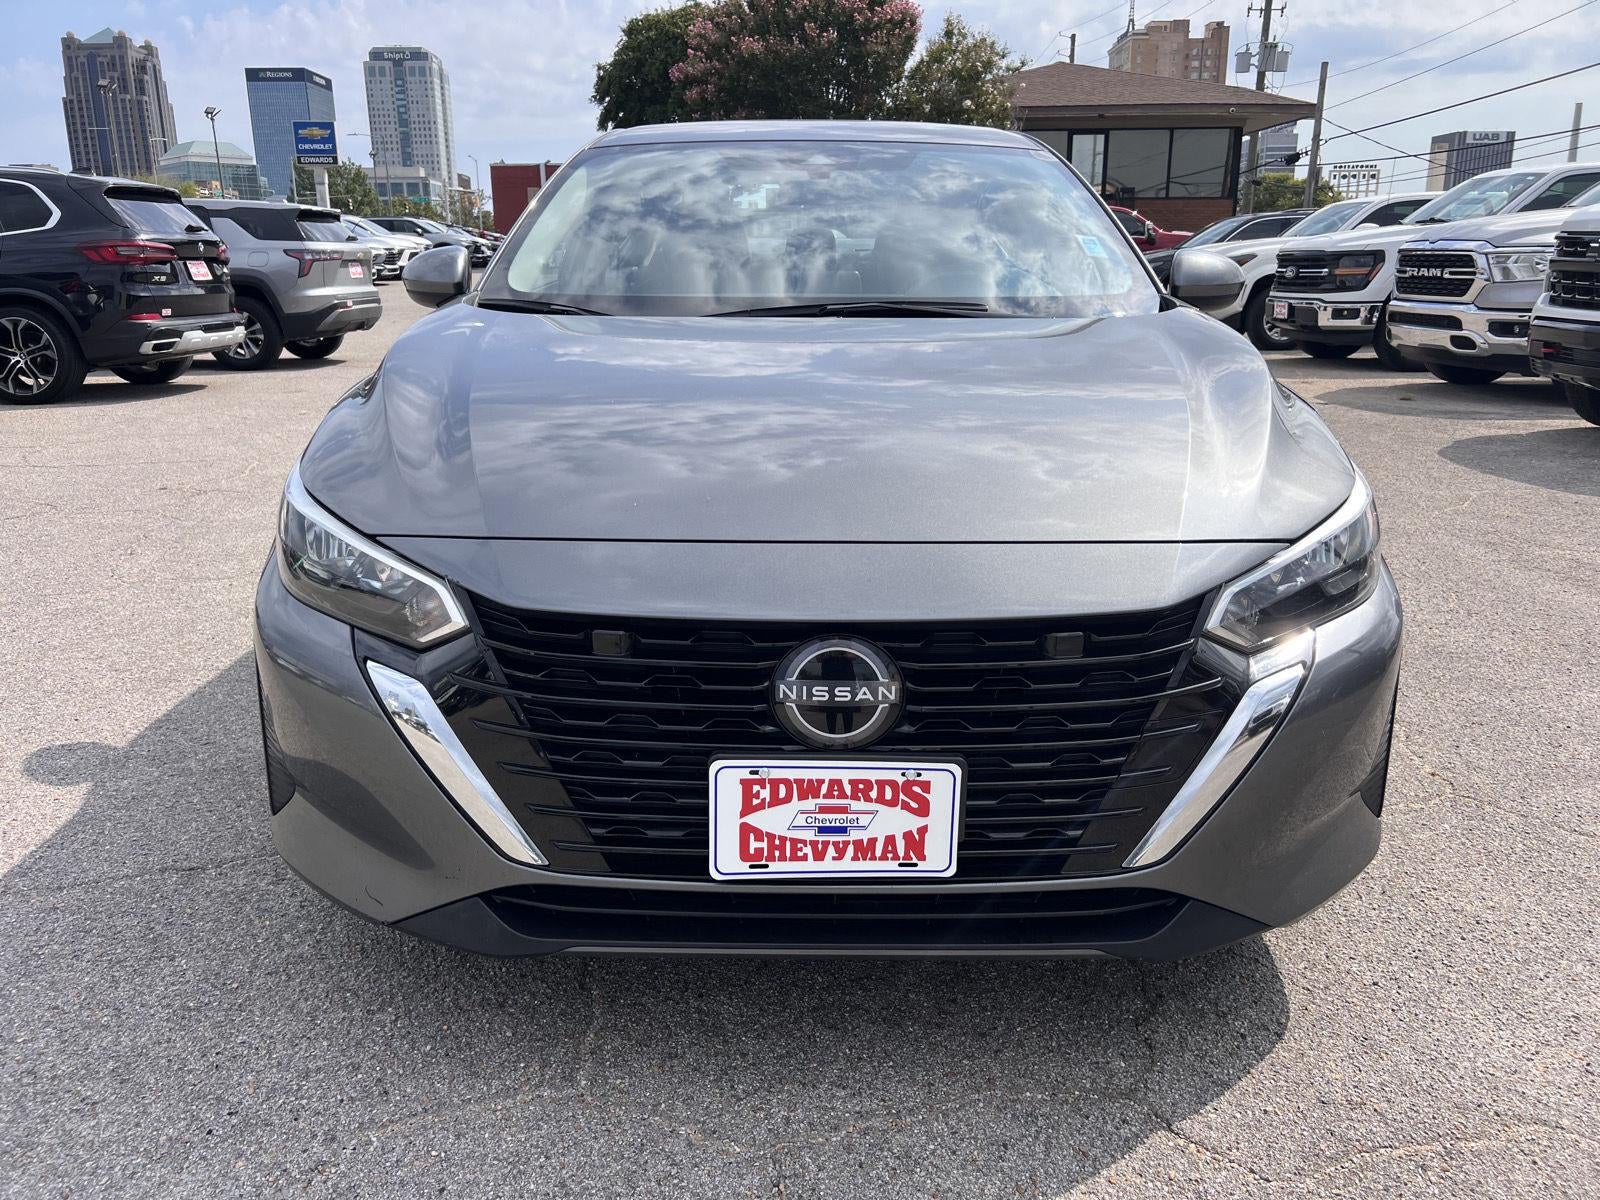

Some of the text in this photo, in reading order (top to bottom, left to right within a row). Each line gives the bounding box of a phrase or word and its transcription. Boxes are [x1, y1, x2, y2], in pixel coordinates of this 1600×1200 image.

[383, 52, 404, 60] Shipt
[1472, 133, 1500, 141] UAB
[1407, 267, 1442, 277] RAM
[779, 684, 896, 702] NISSAN
[739, 777, 932, 820] EDWARDS
[804, 815, 860, 826] Chevrolet
[739, 821, 929, 863] CHEVYMAN
